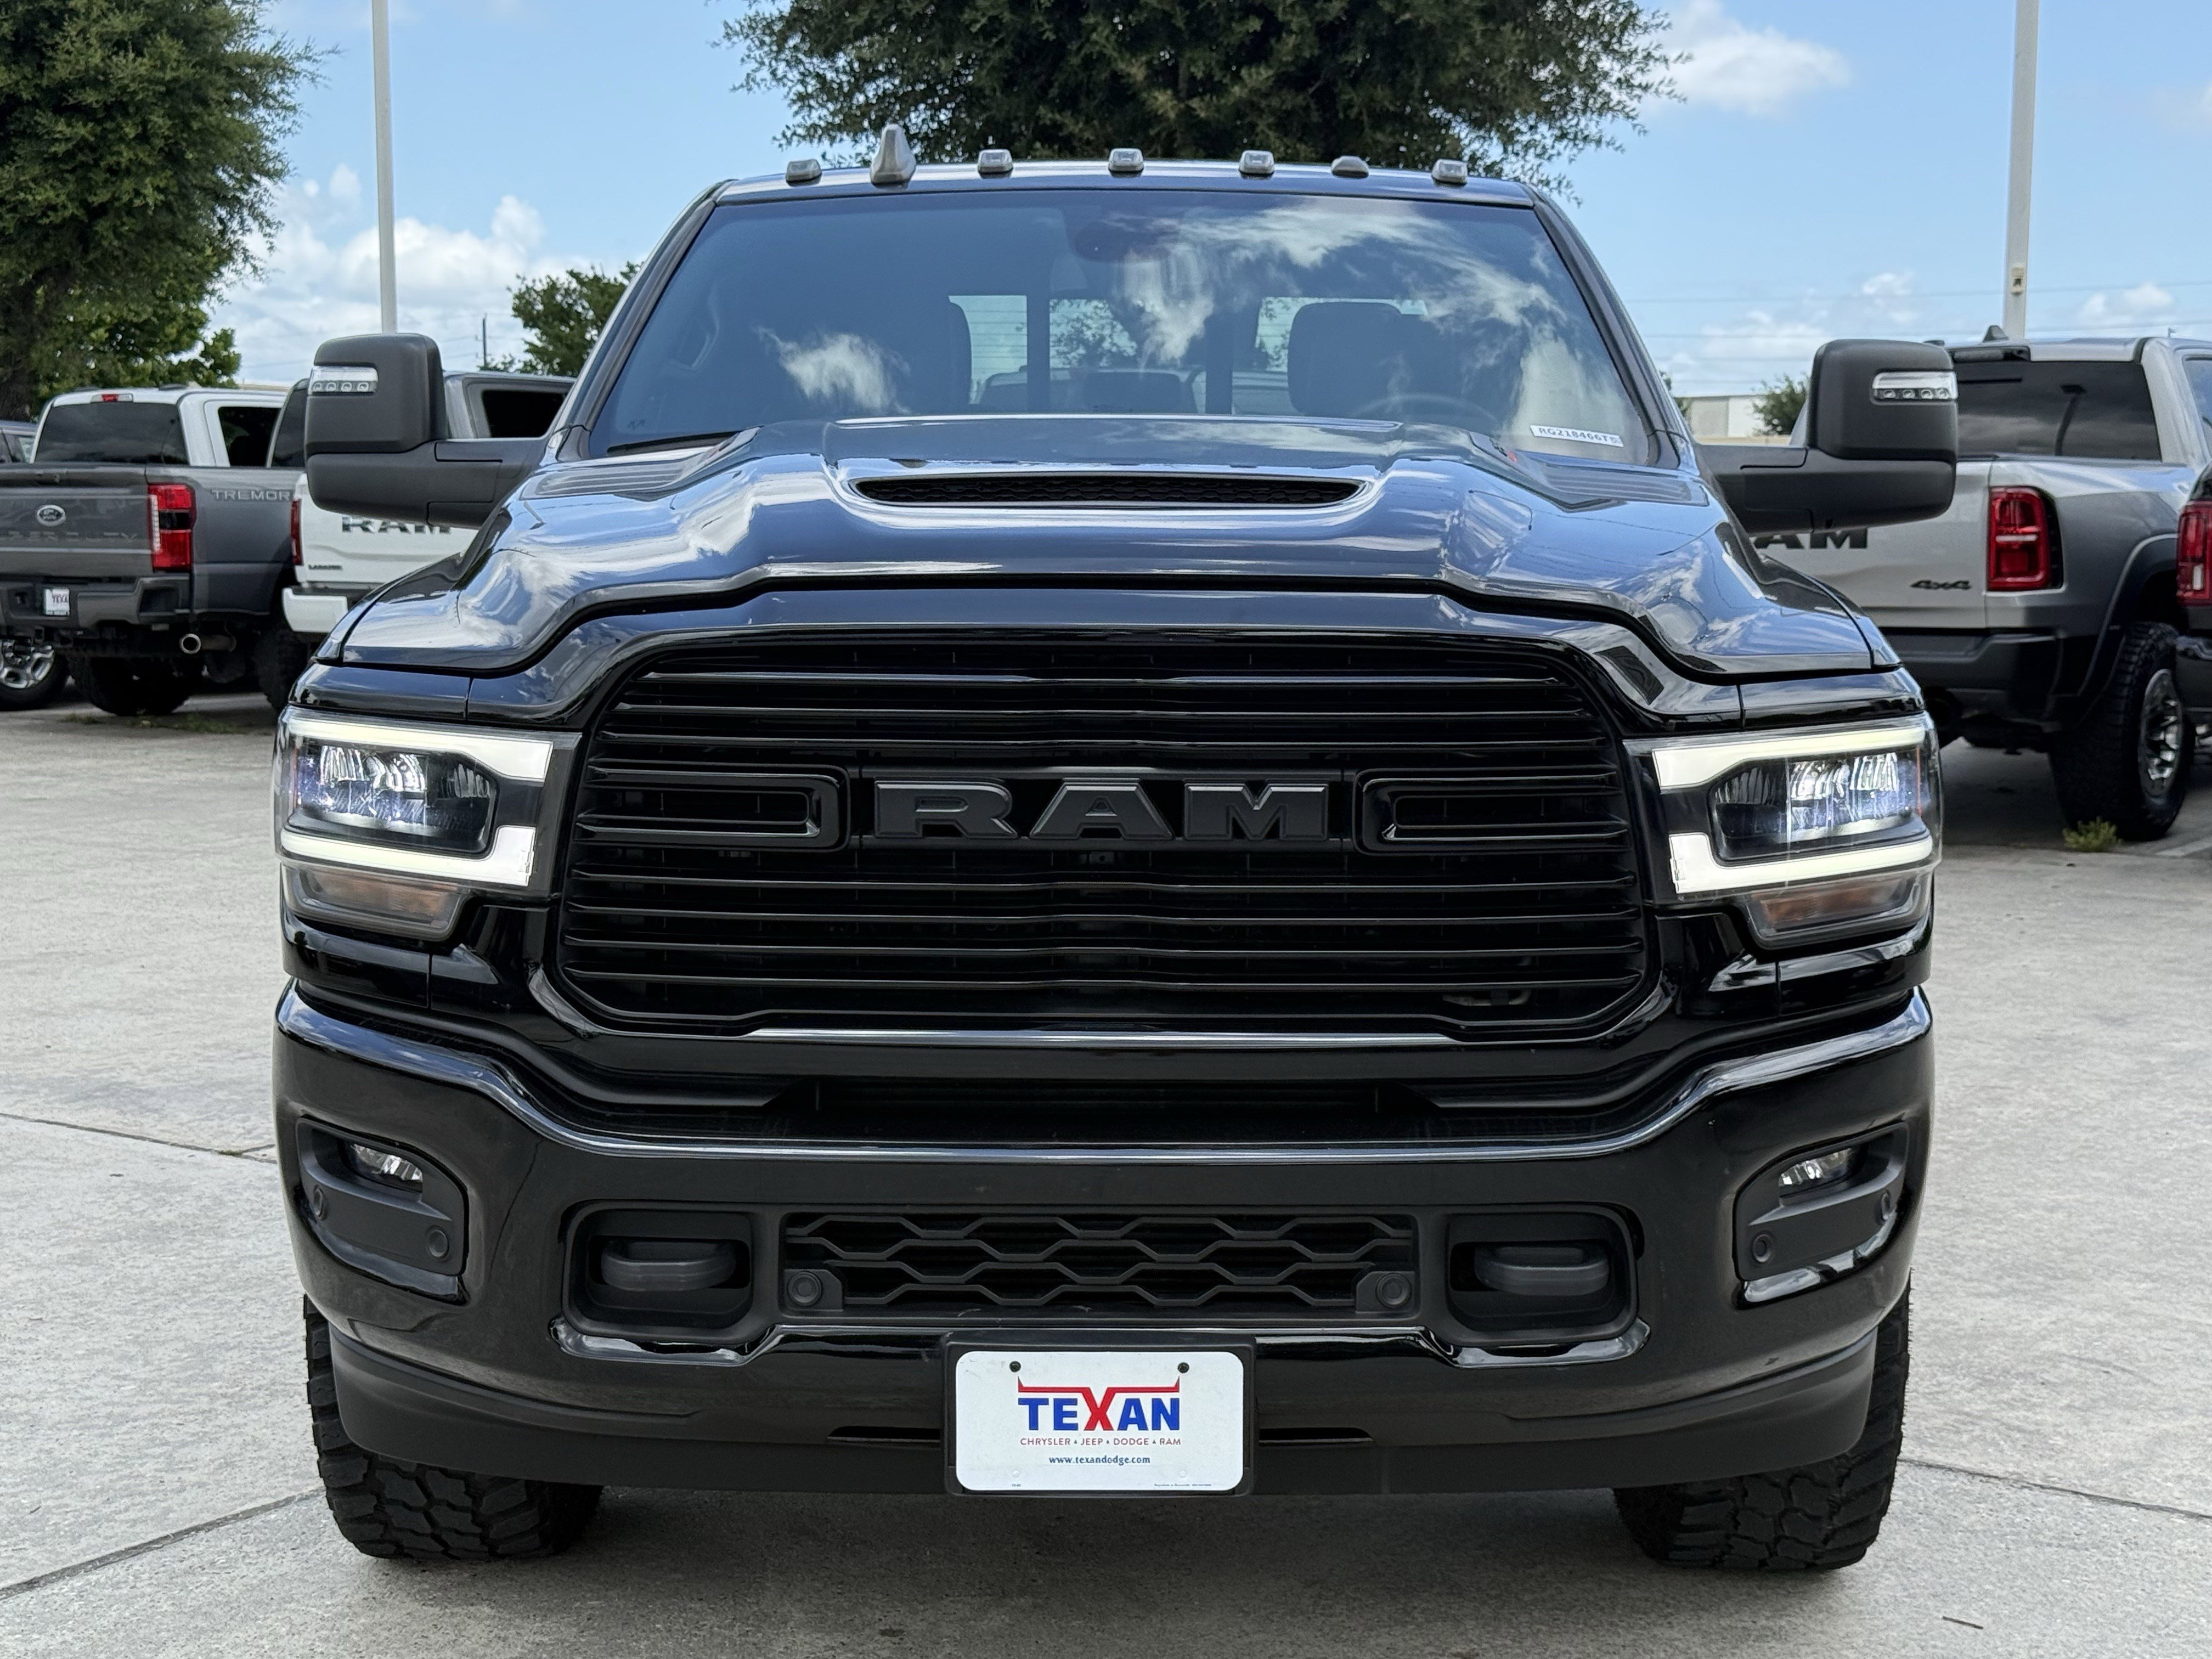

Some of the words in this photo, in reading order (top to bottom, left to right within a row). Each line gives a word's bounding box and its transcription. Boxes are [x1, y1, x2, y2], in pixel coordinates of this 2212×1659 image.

[1753, 528, 1867, 549] AM
[874, 778, 1328, 839] RAM
[1018, 1386, 1180, 1431] TEXAN
[1020, 1437, 1071, 1446] CHRYSLER
[1080, 1437, 1104, 1446] JEEP
[1113, 1437, 1149, 1446] DODGE
[1159, 1437, 1182, 1446] RAM
[1048, 1455, 1150, 1466] www.texandodge.com
